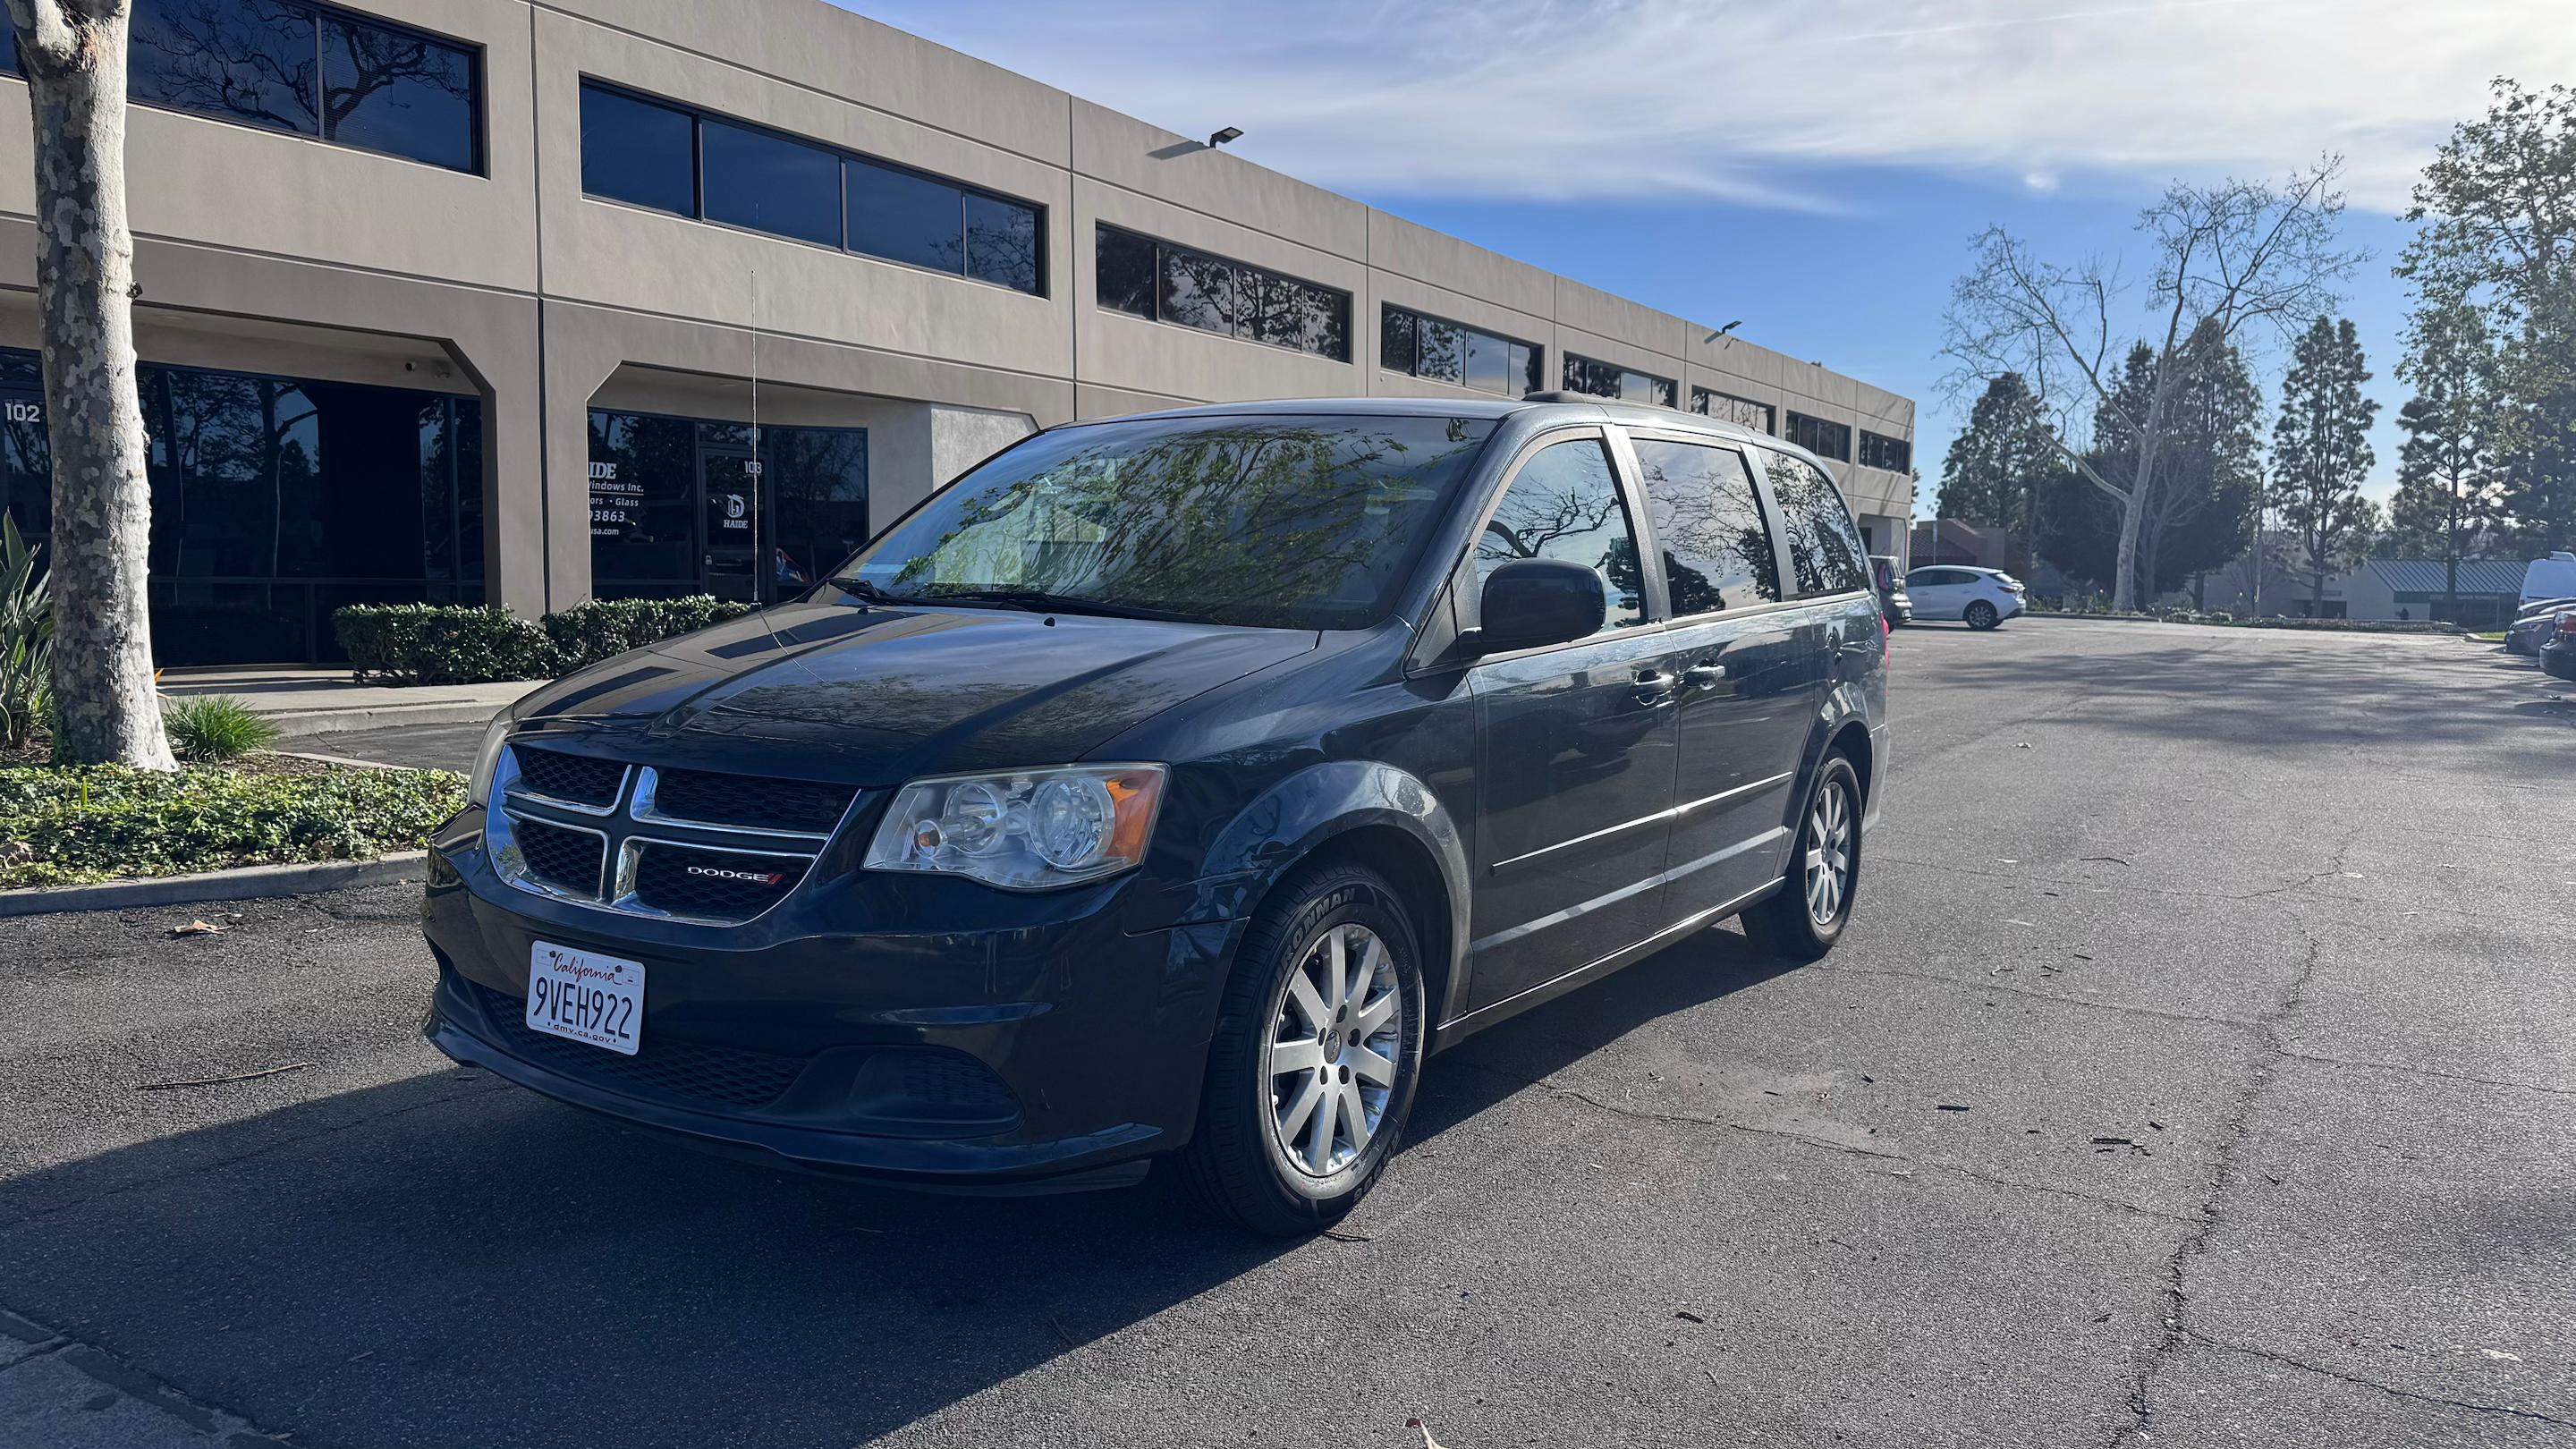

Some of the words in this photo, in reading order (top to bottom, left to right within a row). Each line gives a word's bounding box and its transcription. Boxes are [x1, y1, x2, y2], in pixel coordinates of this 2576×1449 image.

[4, 402, 40, 422] 102
[744, 461, 762, 474] 103
[589, 480, 625, 491] indows
[628, 483, 644, 492] Inc.
[615, 498, 640, 506] Glass
[724, 519, 749, 529] HAIDE
[688, 867, 769, 882] DODGE
[554, 953, 623, 986] California
[533, 977, 632, 1039] 9VEH922
[554, 1023, 611, 1043] dmv.ca.gov
